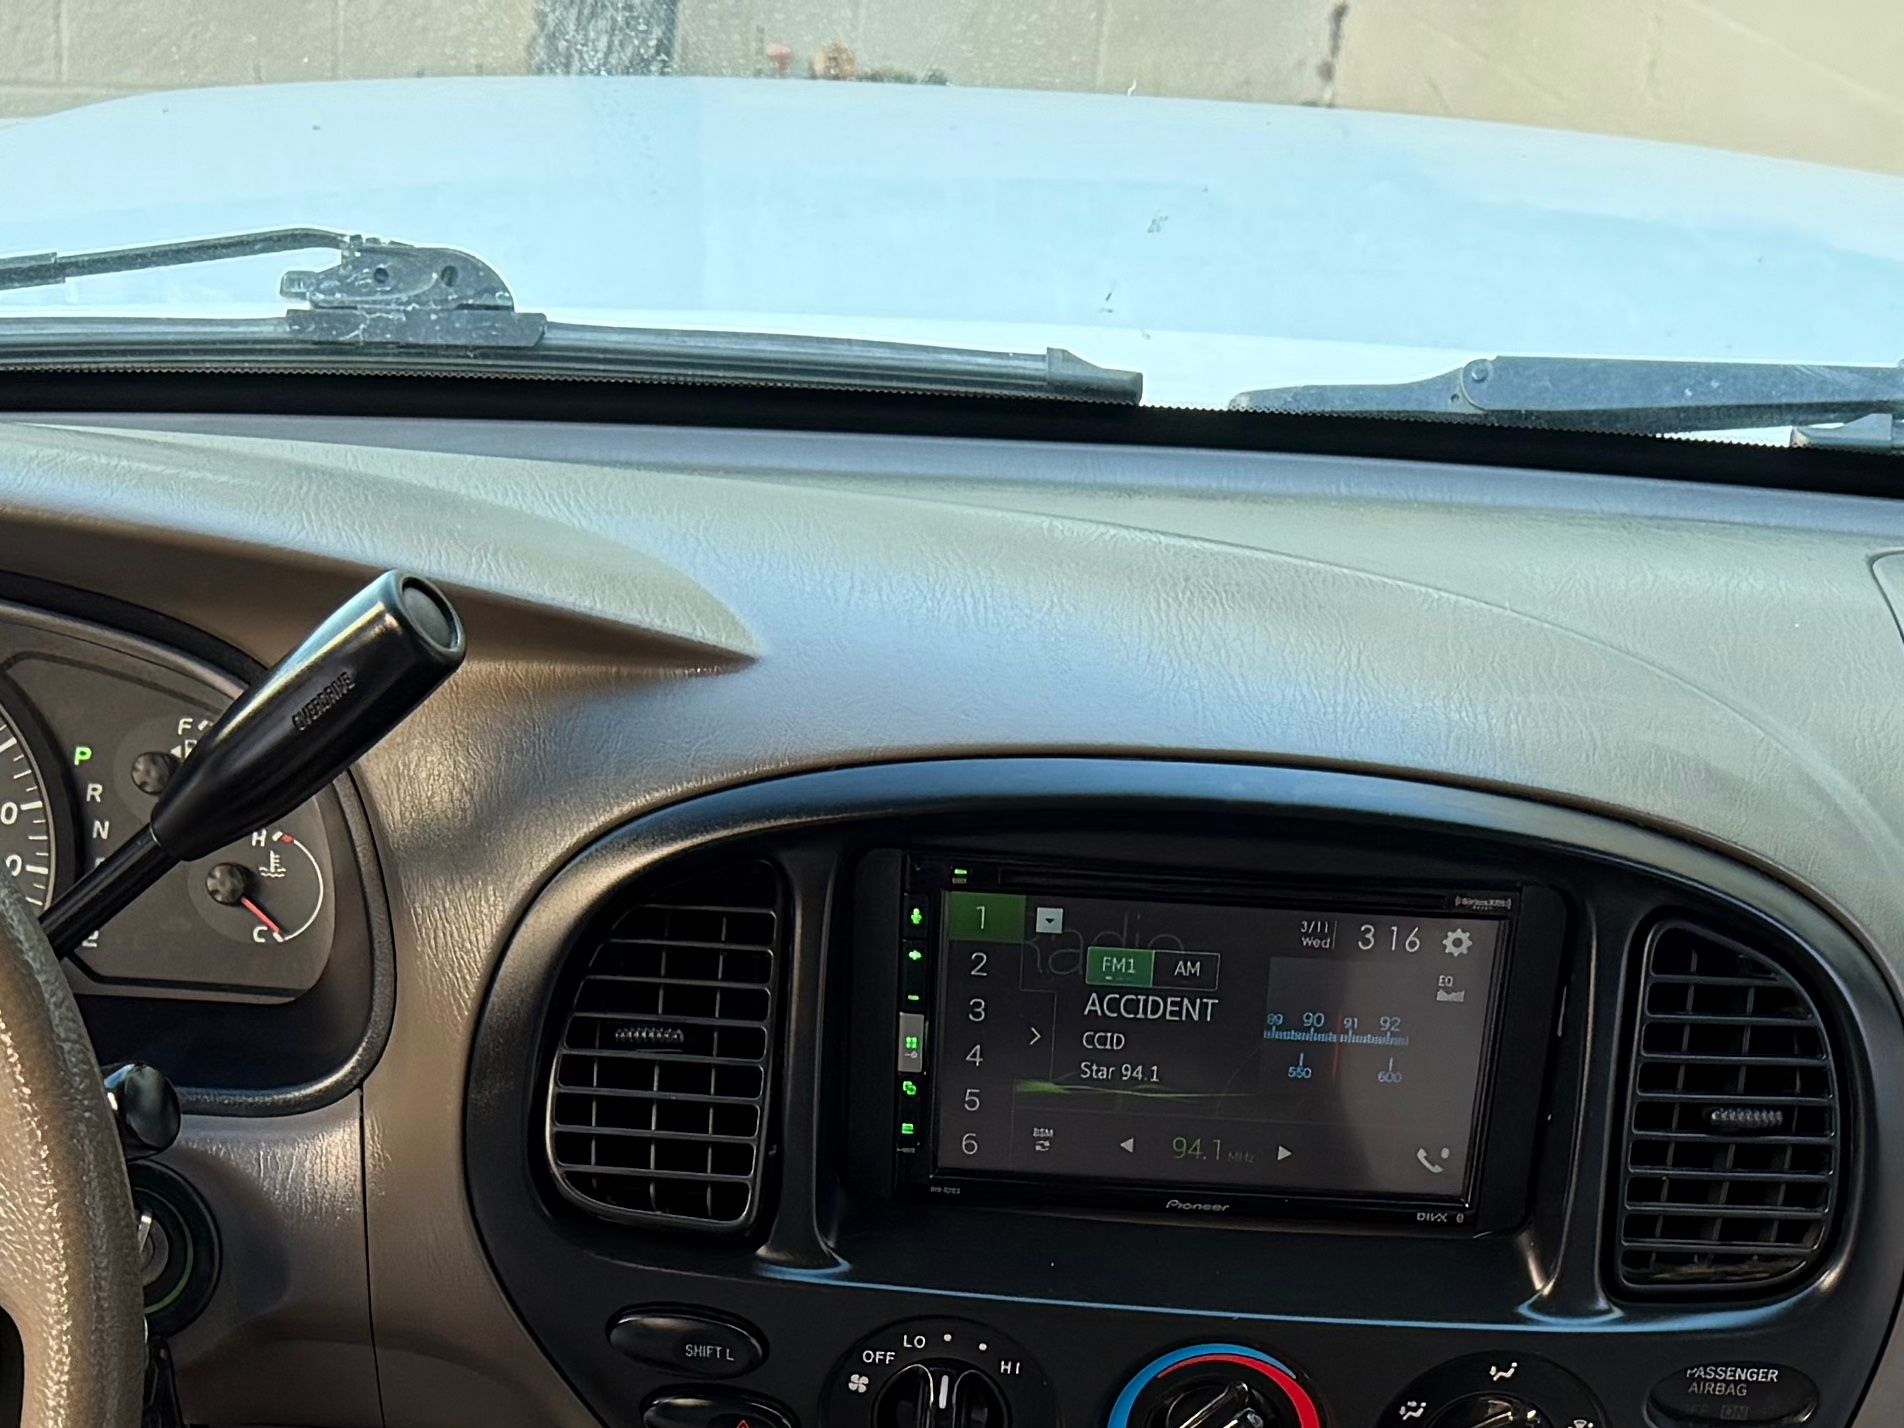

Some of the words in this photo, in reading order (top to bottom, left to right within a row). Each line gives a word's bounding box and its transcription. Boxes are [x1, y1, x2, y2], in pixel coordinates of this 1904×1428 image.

[178, 718, 193, 735] F
[74, 746, 92, 766] P
[86, 783, 103, 803] R
[92, 820, 109, 839] N
[252, 828, 267, 847] H
[976, 906, 987, 929] 1
[1300, 920, 1329, 933] 3/11
[253, 926, 268, 942] C
[1301, 936, 1331, 949] Wed
[970, 952, 988, 976] 2
[1102, 956, 1136, 974] FM1
[1174, 960, 1201, 976] AM
[1438, 975, 1454, 987] EQ
[968, 998, 986, 1021] 3
[1084, 992, 1219, 1021] ACCIDENT
[1302, 1012, 1325, 1028] 90
[1379, 1016, 1401, 1032] 92
[1082, 1031, 1126, 1050] CCID
[965, 1044, 984, 1067] 4
[1080, 1061, 1116, 1080] Star
[1121, 1063, 1160, 1082] 94.1
[963, 1088, 981, 1112] 5
[961, 1132, 979, 1155] 6
[1172, 1136, 1222, 1161] 94.1
[1166, 1199, 1230, 1213] Pioneer
[903, 1334, 927, 1350] LO
[685, 1343, 721, 1360] SHIFT
[862, 1349, 896, 1366] OFF
[1000, 1360, 1022, 1376] HI
[1688, 1381, 1749, 1397] AIRBAG
